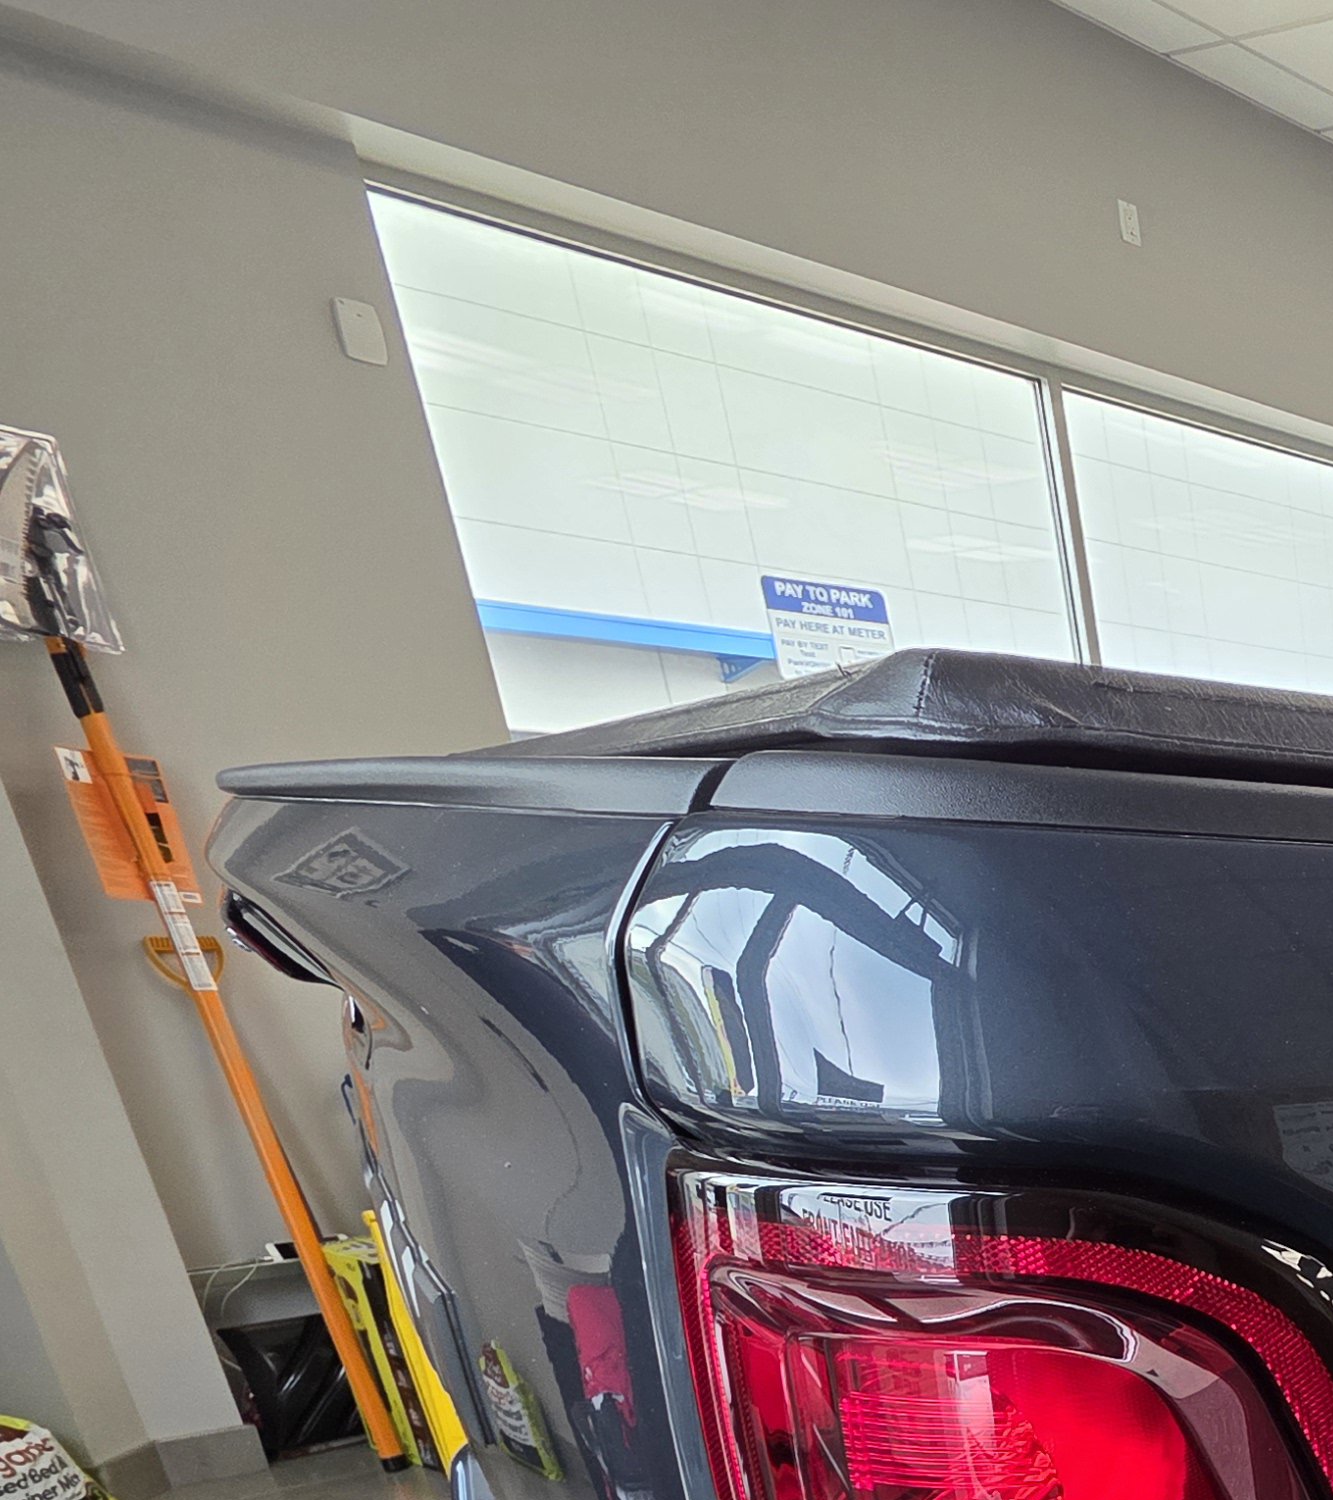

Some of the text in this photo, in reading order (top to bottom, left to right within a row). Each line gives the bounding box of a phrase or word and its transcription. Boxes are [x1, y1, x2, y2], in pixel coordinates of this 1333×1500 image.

[774, 580, 873, 609] PAY TO PARK
[801, 602, 854, 619] ZONE 101
[775, 617, 886, 640] PAY HERE AT METER
[864, 1201, 893, 1222] USE
[28, 1455, 60, 1484] Bed
[57, 1473, 80, 1492] Mix
